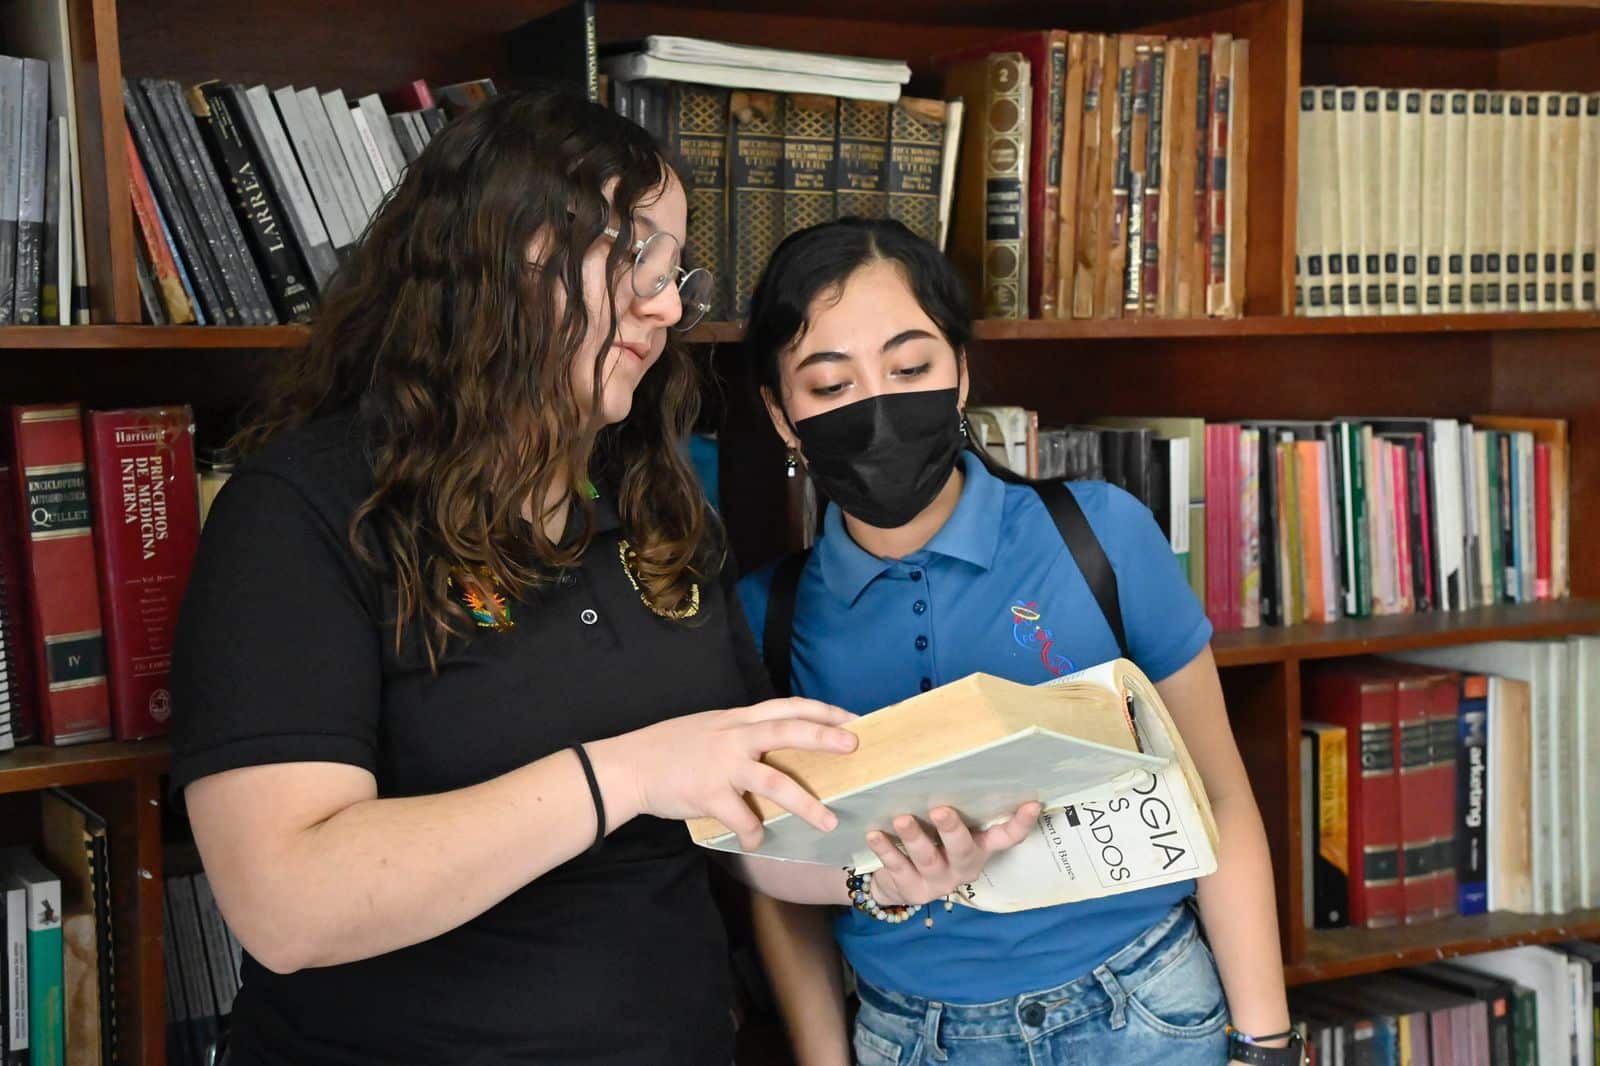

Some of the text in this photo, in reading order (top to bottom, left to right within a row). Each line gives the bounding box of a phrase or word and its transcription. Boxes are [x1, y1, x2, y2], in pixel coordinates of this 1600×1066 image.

[239, 161, 285, 253] LARREA
[120, 457, 138, 525] INTERNA
[135, 457, 157, 560] DE MEDICINA
[149, 455, 169, 541] PRINCIPIOS
[1464, 711, 1486, 828] Marketing
[1058, 849, 1076, 881] Barnes
[1081, 800, 1131, 881] ADOS
